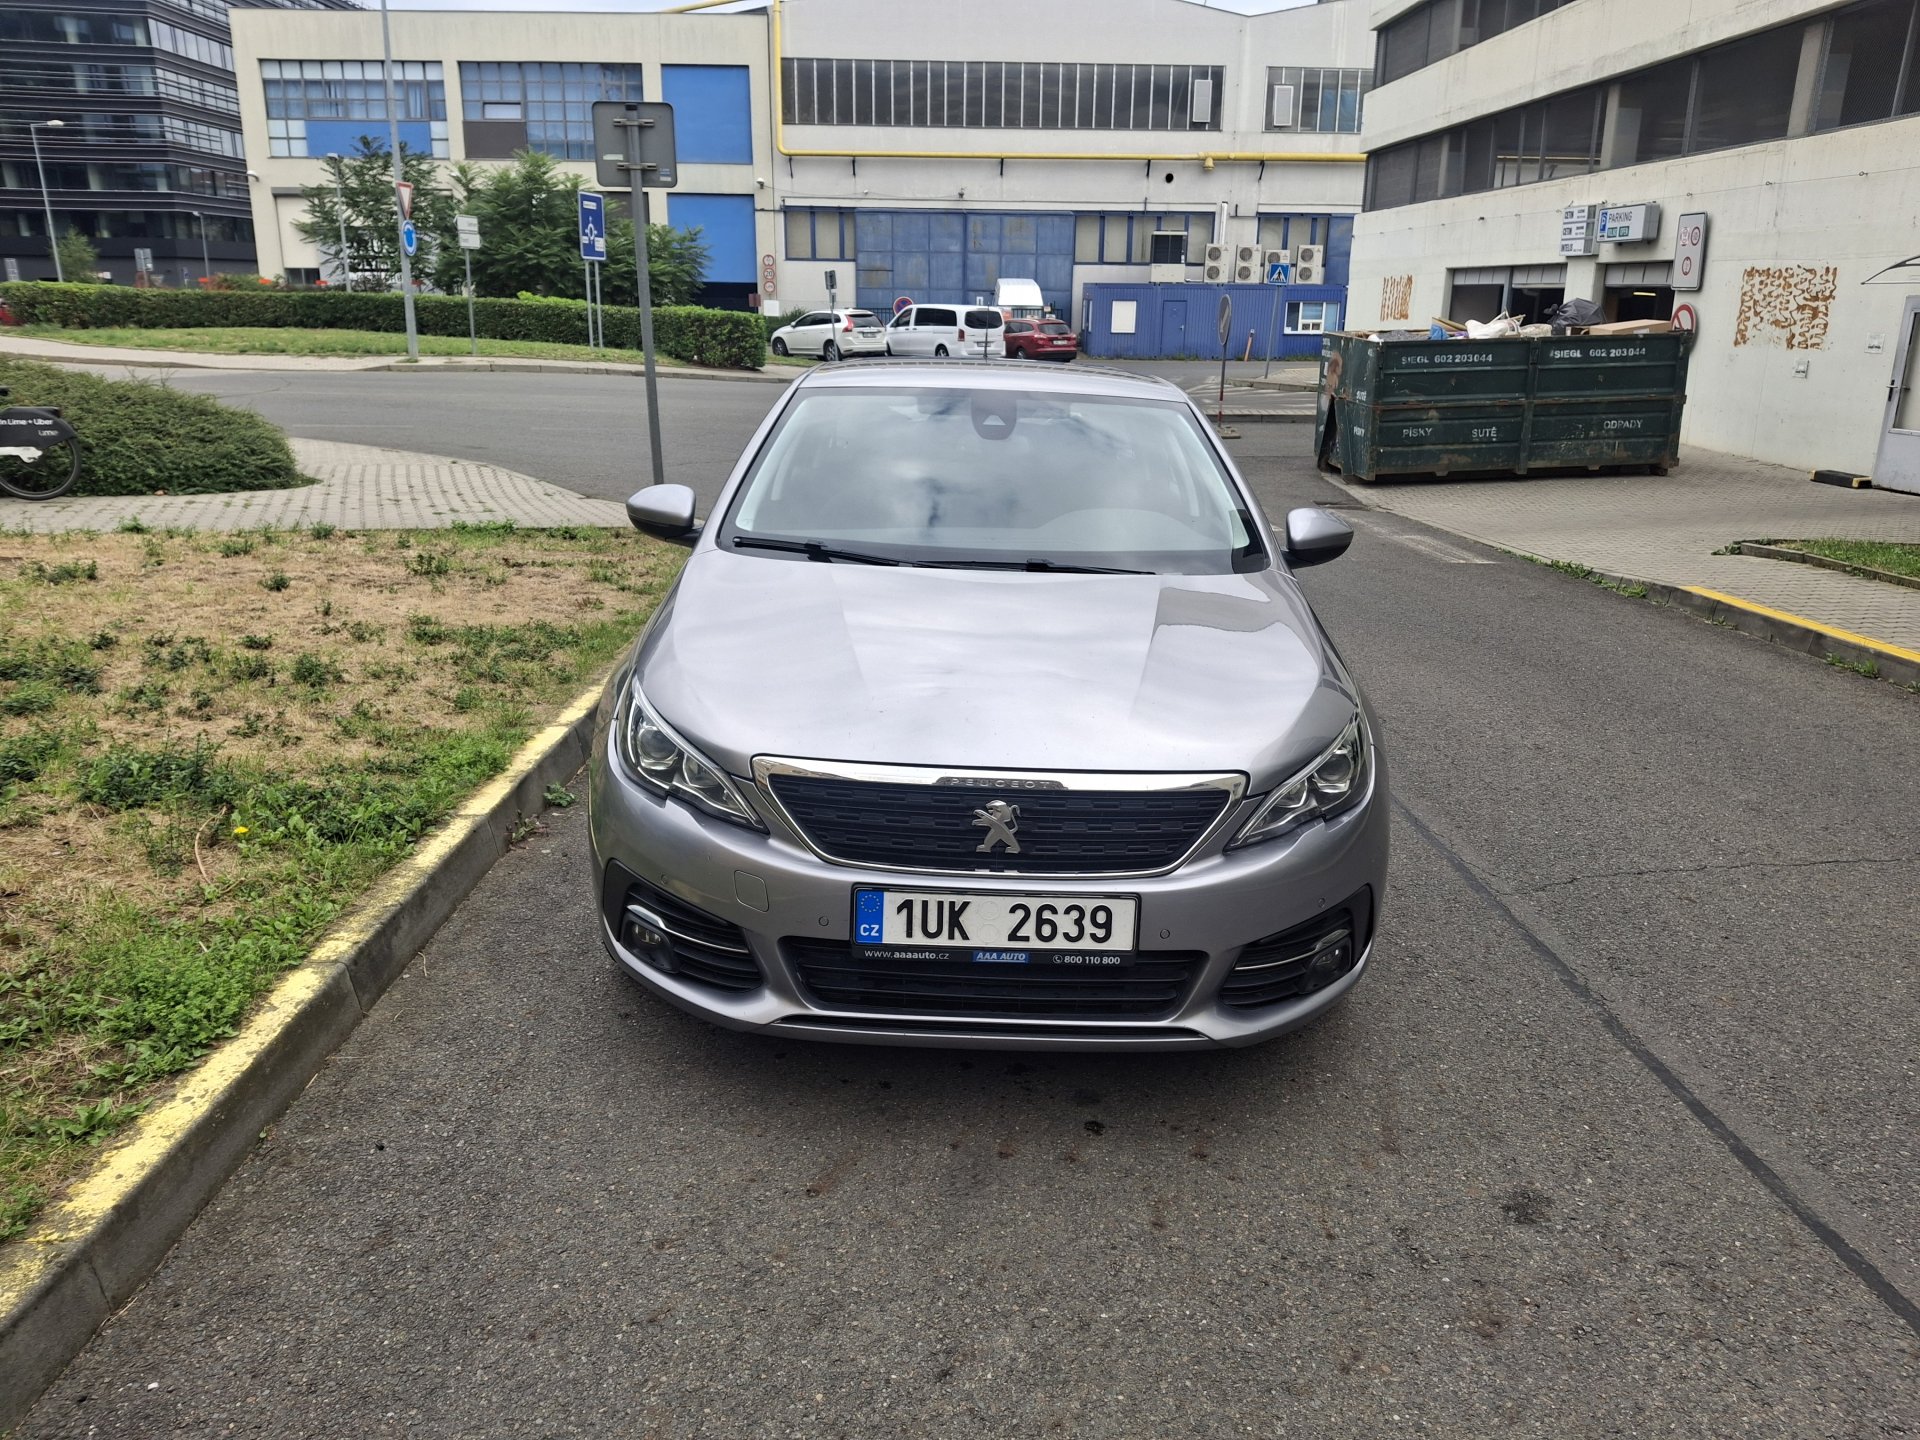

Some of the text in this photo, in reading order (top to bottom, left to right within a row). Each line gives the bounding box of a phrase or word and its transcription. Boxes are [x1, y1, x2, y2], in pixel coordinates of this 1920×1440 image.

[1608, 211, 1632, 223] PARKING
[1554, 349, 1581, 358] SIEGL
[1589, 348, 1607, 357] 602
[1401, 355, 1429, 365] SIEGL
[1434, 354, 1453, 364] 602
[7, 418, 27, 426] Lime
[33, 418, 53, 426] Uber
[1603, 419, 1643, 429] ODPADY
[950, 778, 1050, 789] PEUGEOT
[860, 898, 1113, 944] CZ 1UK 2639
[864, 950, 950, 960] www.aaaauto.cz
[977, 952, 1026, 961] AAA AUTO
[1064, 955, 1121, 965] 800 110 800
